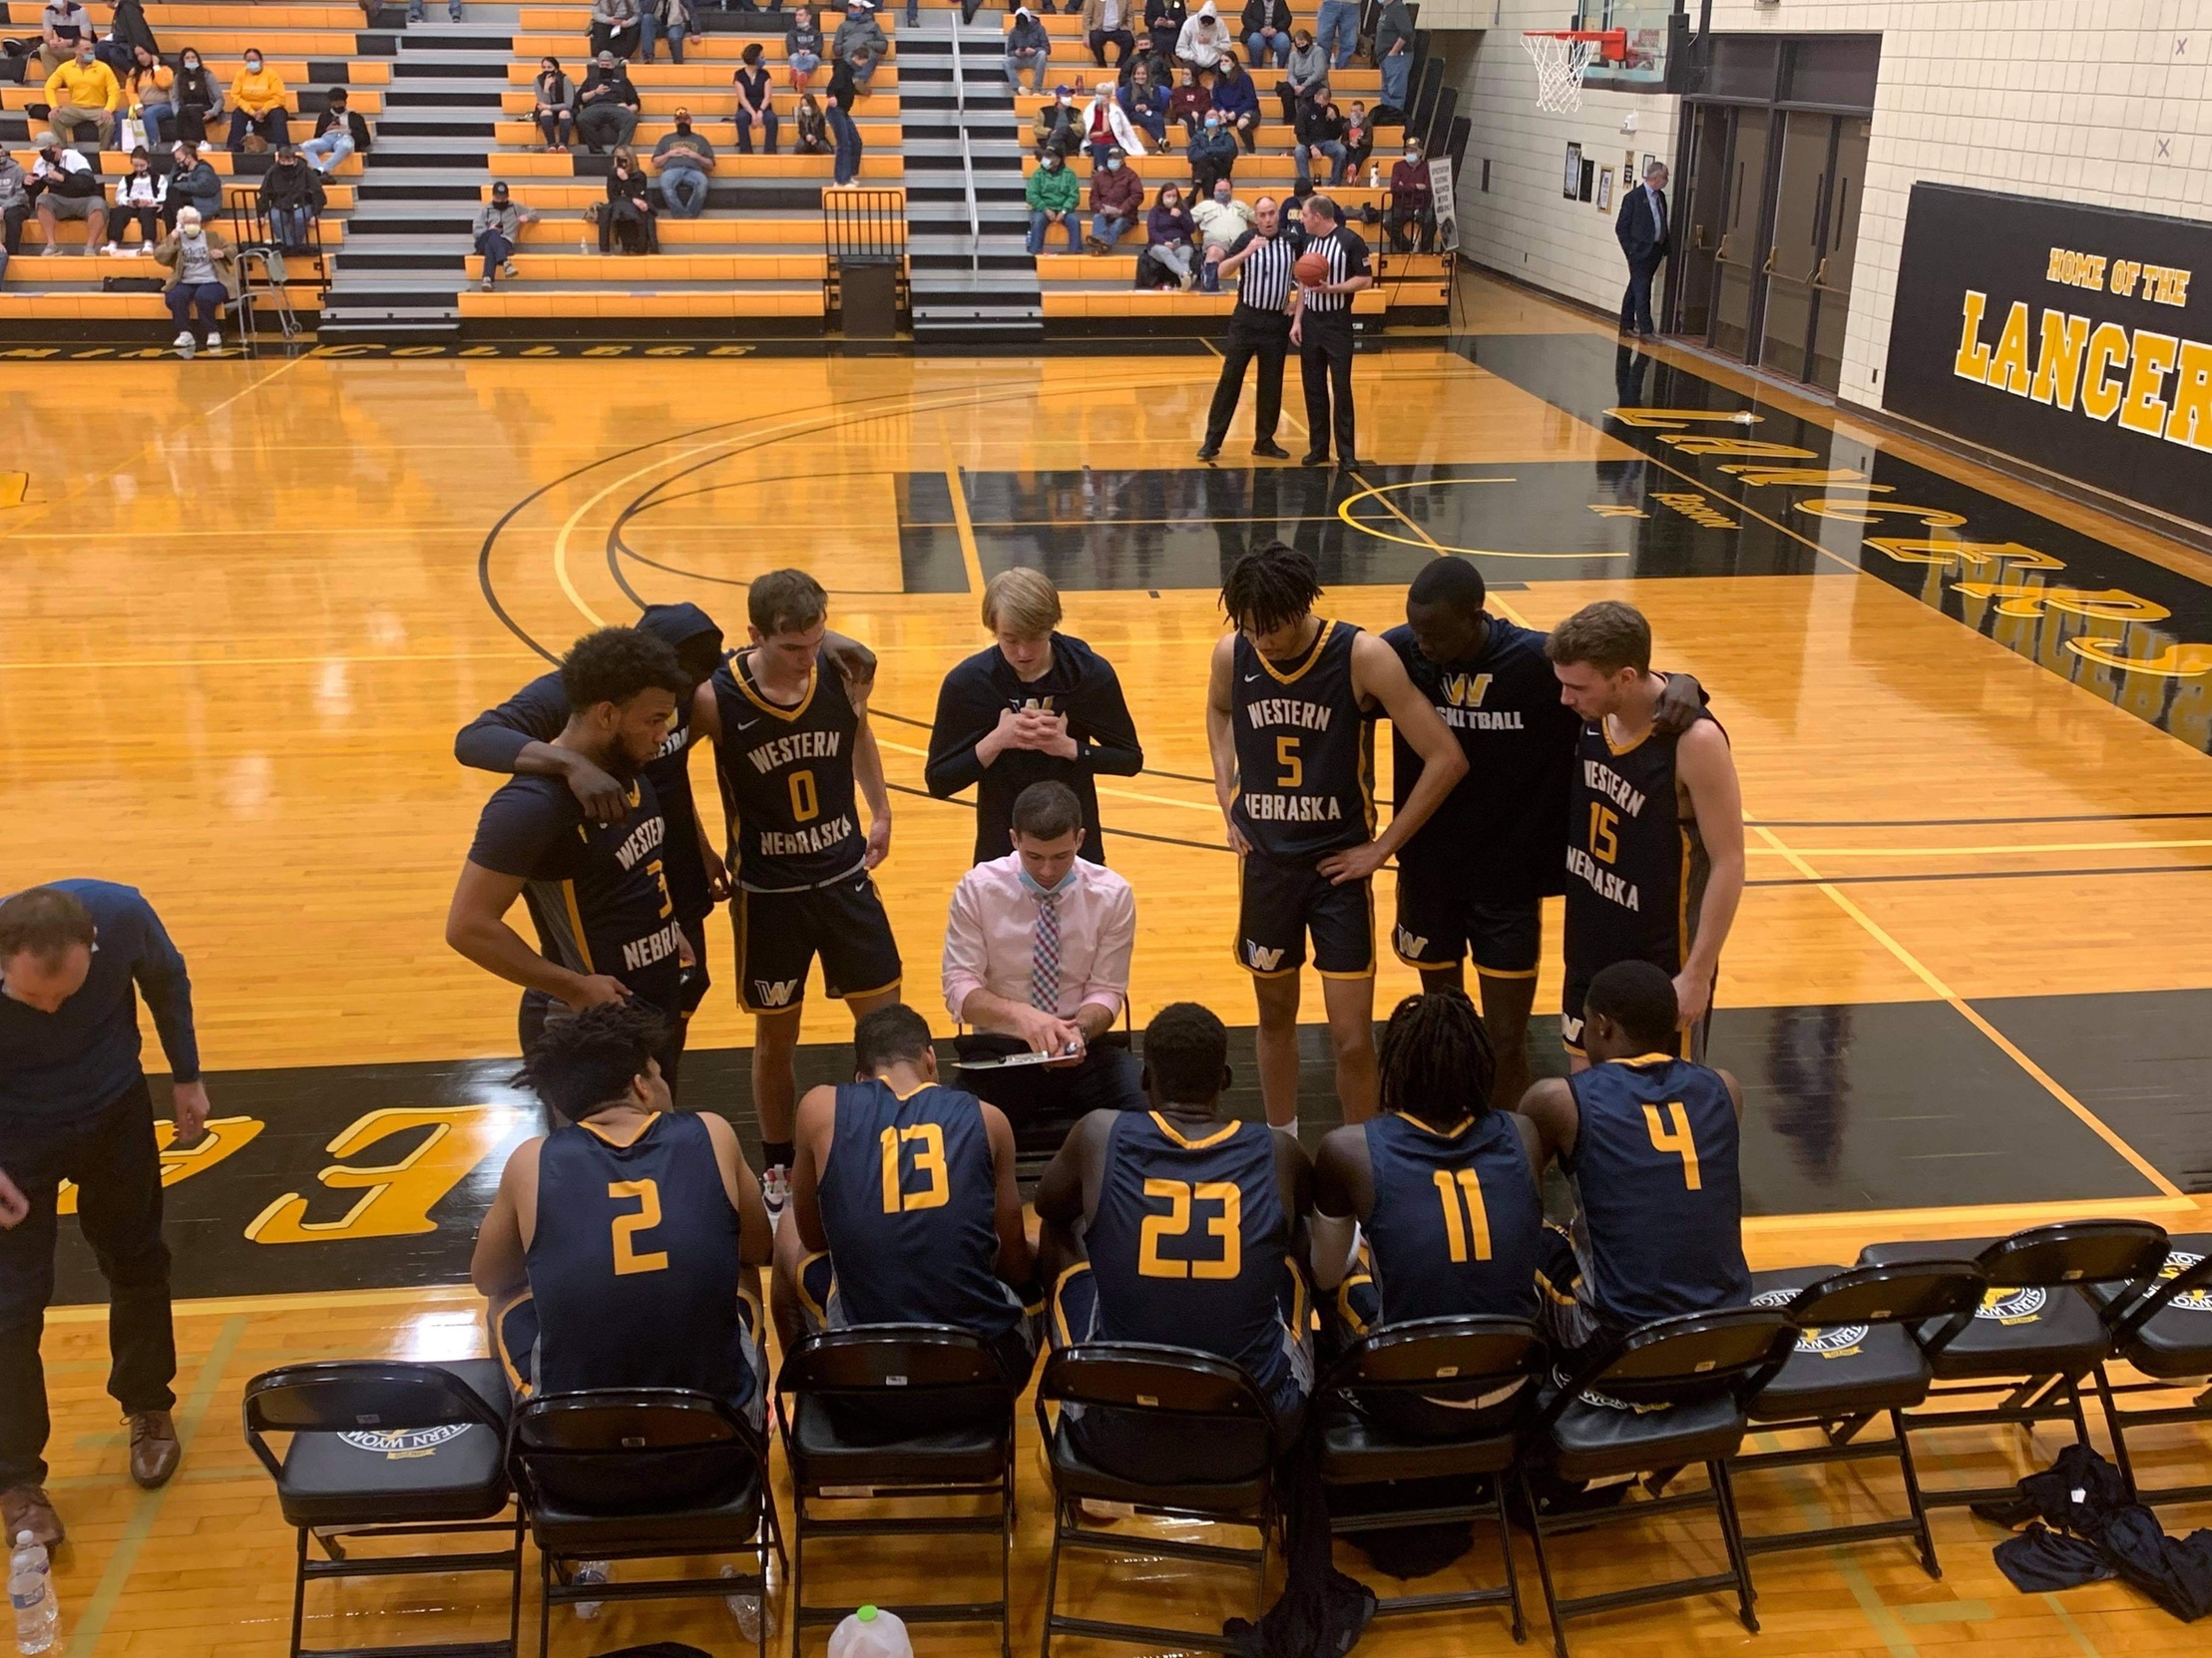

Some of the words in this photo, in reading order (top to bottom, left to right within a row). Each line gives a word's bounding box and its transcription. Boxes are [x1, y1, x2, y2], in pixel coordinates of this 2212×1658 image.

[2046, 247, 2107, 291] HOME
[2110, 259, 2141, 296] OF
[2142, 264, 2191, 307] THE
[313, 343, 756, 359] COLLEGE
[1954, 289, 2212, 454] LANCER
[1602, 407, 2212, 677] LANCERS
[1247, 699, 1331, 732] WESTERN
[747, 731, 840, 774] WESTERN
[1276, 736, 1303, 787] 5
[788, 769, 819, 822] 0
[1583, 759, 1646, 818] WESTERN
[615, 816, 665, 871] WESTER
[761, 814, 852, 856] NEBRASKA
[1589, 801, 1619, 865] 15
[646, 859, 672, 919] 3
[1566, 845, 1639, 913] NEBRASKA
[879, 1122, 950, 1214] 13
[1641, 1101, 1701, 1190] 4
[608, 1178, 668, 1276] 2
[1138, 1178, 1241, 1280] 23
[1433, 1168, 1493, 1262] 11
